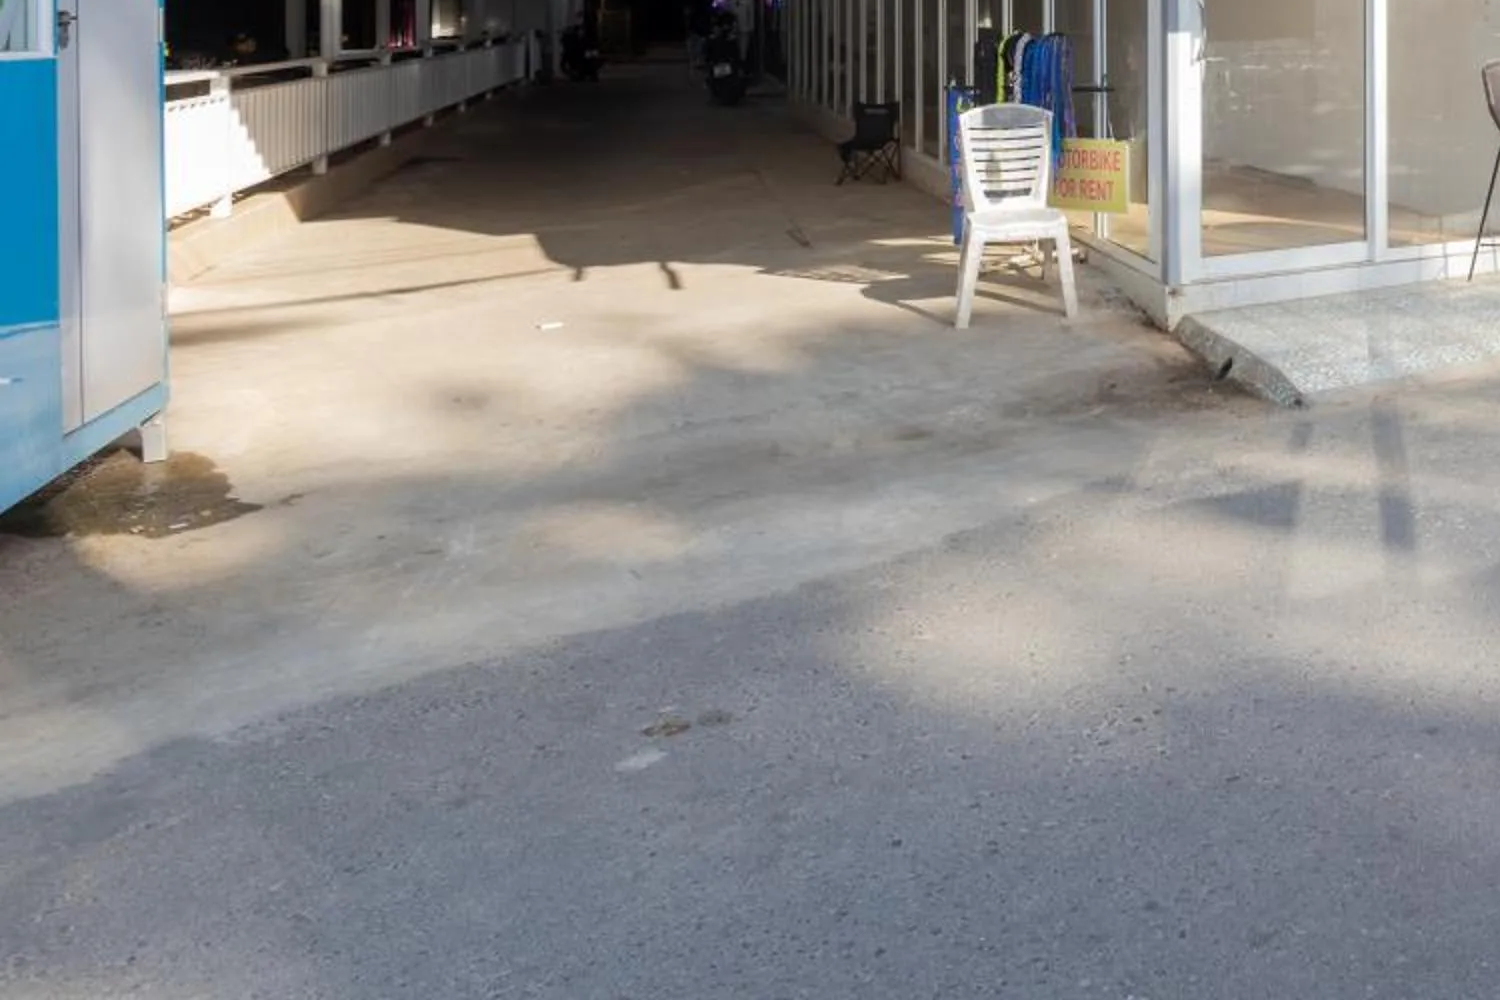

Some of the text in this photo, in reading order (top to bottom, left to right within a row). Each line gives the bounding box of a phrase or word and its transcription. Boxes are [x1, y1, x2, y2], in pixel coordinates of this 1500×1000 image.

[1058, 147, 1121, 172] OTORBIKE
[1057, 177, 1115, 201] OR RENT
